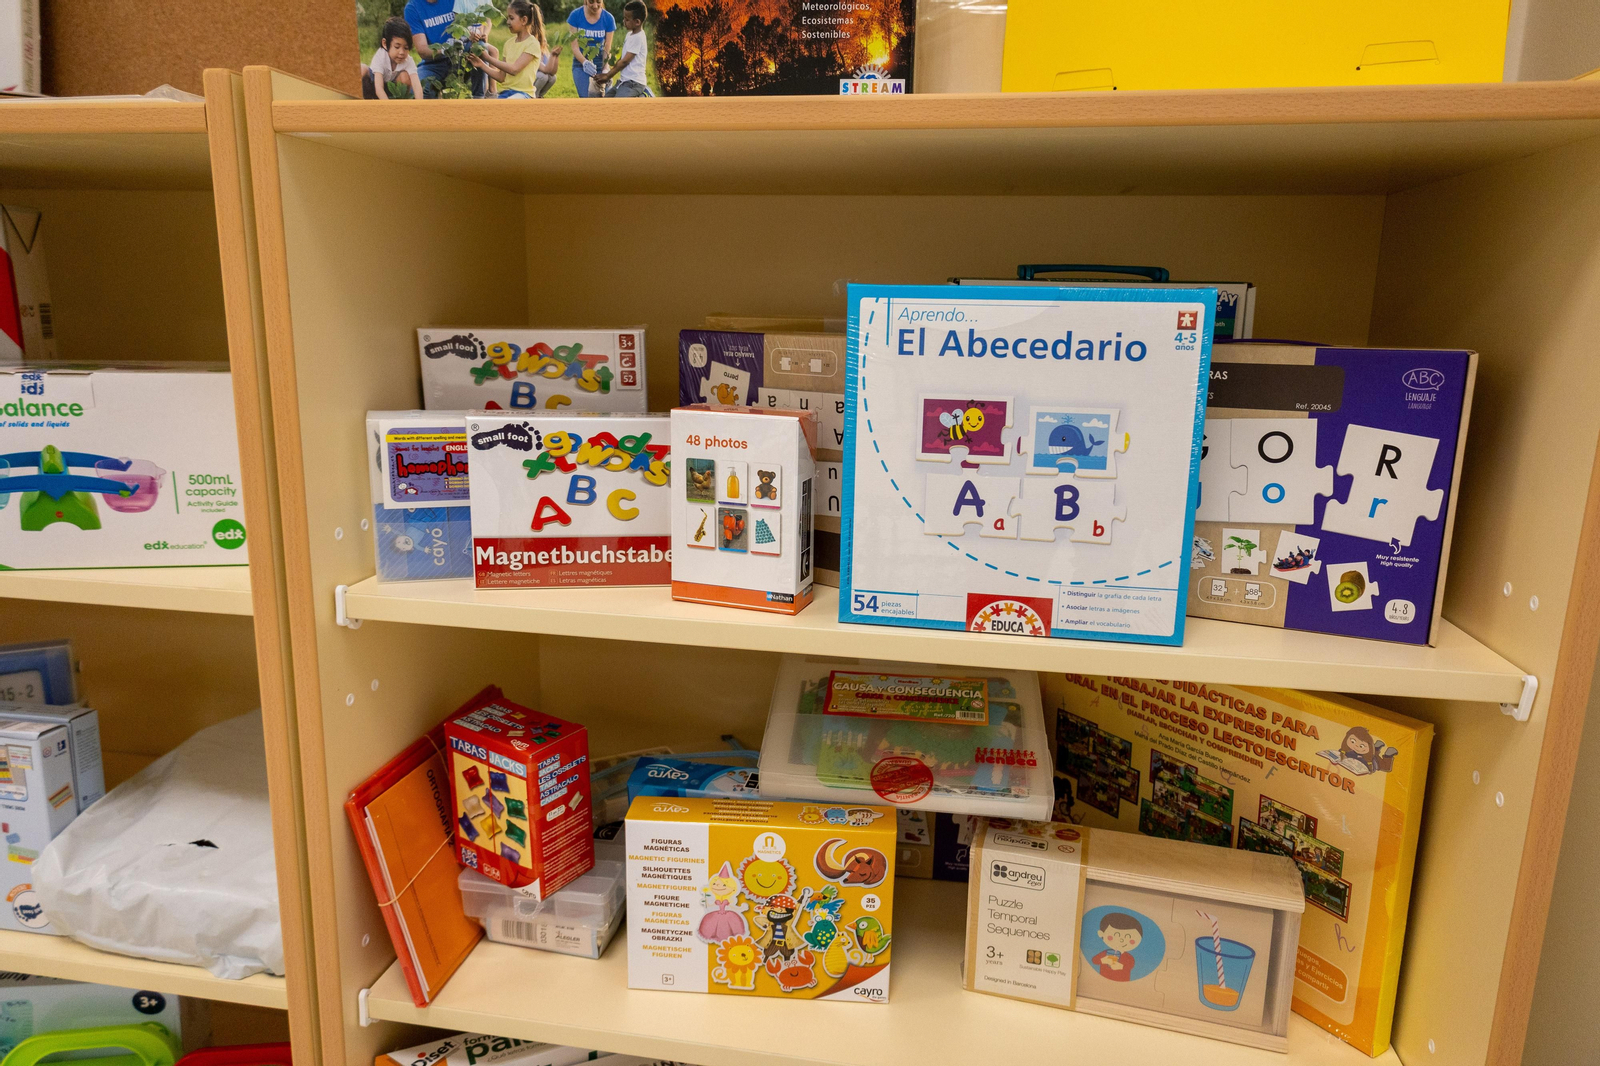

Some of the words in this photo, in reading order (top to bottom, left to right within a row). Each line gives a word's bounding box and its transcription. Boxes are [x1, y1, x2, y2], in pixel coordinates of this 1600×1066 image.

[802, 1, 873, 12] Meteorológicos,
[802, 16, 854, 25] Ecosistemas
[801, 30, 851, 39] Sostenibles
[842, 82, 903, 93] STREAM
[897, 306, 979, 324] Aprendo...
[621, 339, 633, 348] 3+
[1174, 332, 1197, 344] 4-5
[430, 343, 454, 354] small
[455, 342, 474, 353] foot
[897, 328, 926, 356] El
[938, 328, 1147, 362] Abecedario
[1174, 342, 1195, 352] años
[623, 375, 634, 383] 52
[723, 371, 739, 381] perro
[1407, 371, 1440, 386] ABC
[510, 381, 537, 409] B
[1405, 392, 1437, 402] LENGUAJE
[46, 421, 70, 429] liquids
[477, 434, 505, 445] small
[507, 432, 529, 443] foot
[686, 434, 701, 446] 48
[704, 435, 748, 450] photos
[1257, 431, 1294, 463] O
[1374, 443, 1402, 480] R
[189, 474, 233, 485] 500mL
[185, 486, 237, 497] capacity
[567, 474, 597, 505] B
[1262, 482, 1286, 503] o
[953, 480, 986, 518] A
[1054, 485, 1080, 521] B
[531, 496, 572, 532] A
[606, 488, 640, 521] C
[1368, 497, 1389, 519] r
[993, 518, 1005, 531] a
[1092, 520, 1105, 537] b
[426, 527, 448, 566] cayó
[1390, 555, 1420, 563] resistente
[1067, 590, 1096, 598] Distinguir
[1213, 584, 1223, 592] 32
[1249, 588, 1259, 596] 88
[770, 592, 793, 603] Nathan
[853, 594, 879, 613] 54
[881, 608, 915, 616] encajables
[1111, 606, 1140, 614] imágenes
[991, 620, 1024, 633] EDUCA
[1065, 618, 1088, 626] Ampliar
[833, 681, 875, 693] CAUSA
[887, 685, 983, 699] CONSECUENCIA
[1173, 679, 1267, 721] DIDÁCTICAS
[1272, 711, 1320, 741] PARA
[1180, 696, 1200, 715] LA
[1203, 705, 1297, 751] EXPRESIÓN
[1101, 683, 1119, 699] EN
[1122, 692, 1138, 708] EL
[1141, 698, 1209, 735] PROCESO
[1213, 727, 1356, 795] LECTOESCRITOR
[1158, 721, 1198, 742] ESCUCHAR
[1206, 739, 1264, 769] COMPRENDER)
[449, 735, 487, 760] TABAS
[1149, 736, 1157, 744] del
[1158, 740, 1174, 752] Prado
[1188, 752, 1197, 760] del
[1197, 757, 1218, 770] Castillo
[1158, 733, 1169, 741] Ana
[1170, 737, 1185, 748] María
[1186, 743, 1204, 756] García
[1204, 751, 1223, 764] Bueno
[489, 752, 524, 776] JACKS
[537, 753, 560, 769] TABAS
[975, 753, 1037, 767] HenBea
[648, 769, 690, 781] cayro
[653, 805, 690, 814] cayro
[643, 845, 690, 853] MAGNÉTICAS
[628, 854, 666, 862] MAGNETIC
[667, 856, 705, 864] FIGURINES
[641, 872, 692, 881] MAGNÉTIQUES
[642, 866, 691, 874] SILHOUETTES
[1008, 868, 1042, 882] andreu
[521, 888, 537, 900] cayro
[636, 883, 697, 892] MAGNETFIGUREN
[644, 900, 690, 908] MAGNETICHE
[988, 895, 1024, 910] Puzzle
[644, 917, 690, 926] MAGNÉTICAS
[987, 908, 1038, 926] Temporal
[641, 928, 693, 936] MAGNETYCZNE
[987, 922, 1051, 941] Sequences
[642, 944, 692, 953] MAGNETISCHE
[986, 945, 1005, 959] 3+
[985, 958, 1003, 966] years
[983, 975, 1007, 985] Designed
[1012, 980, 1037, 990] Barcelona
[1298, 969, 1330, 990] compartir
[1311, 965, 1343, 989] Ejercicios
[853, 986, 883, 999] cayro
[139, 996, 158, 1008] 3+
